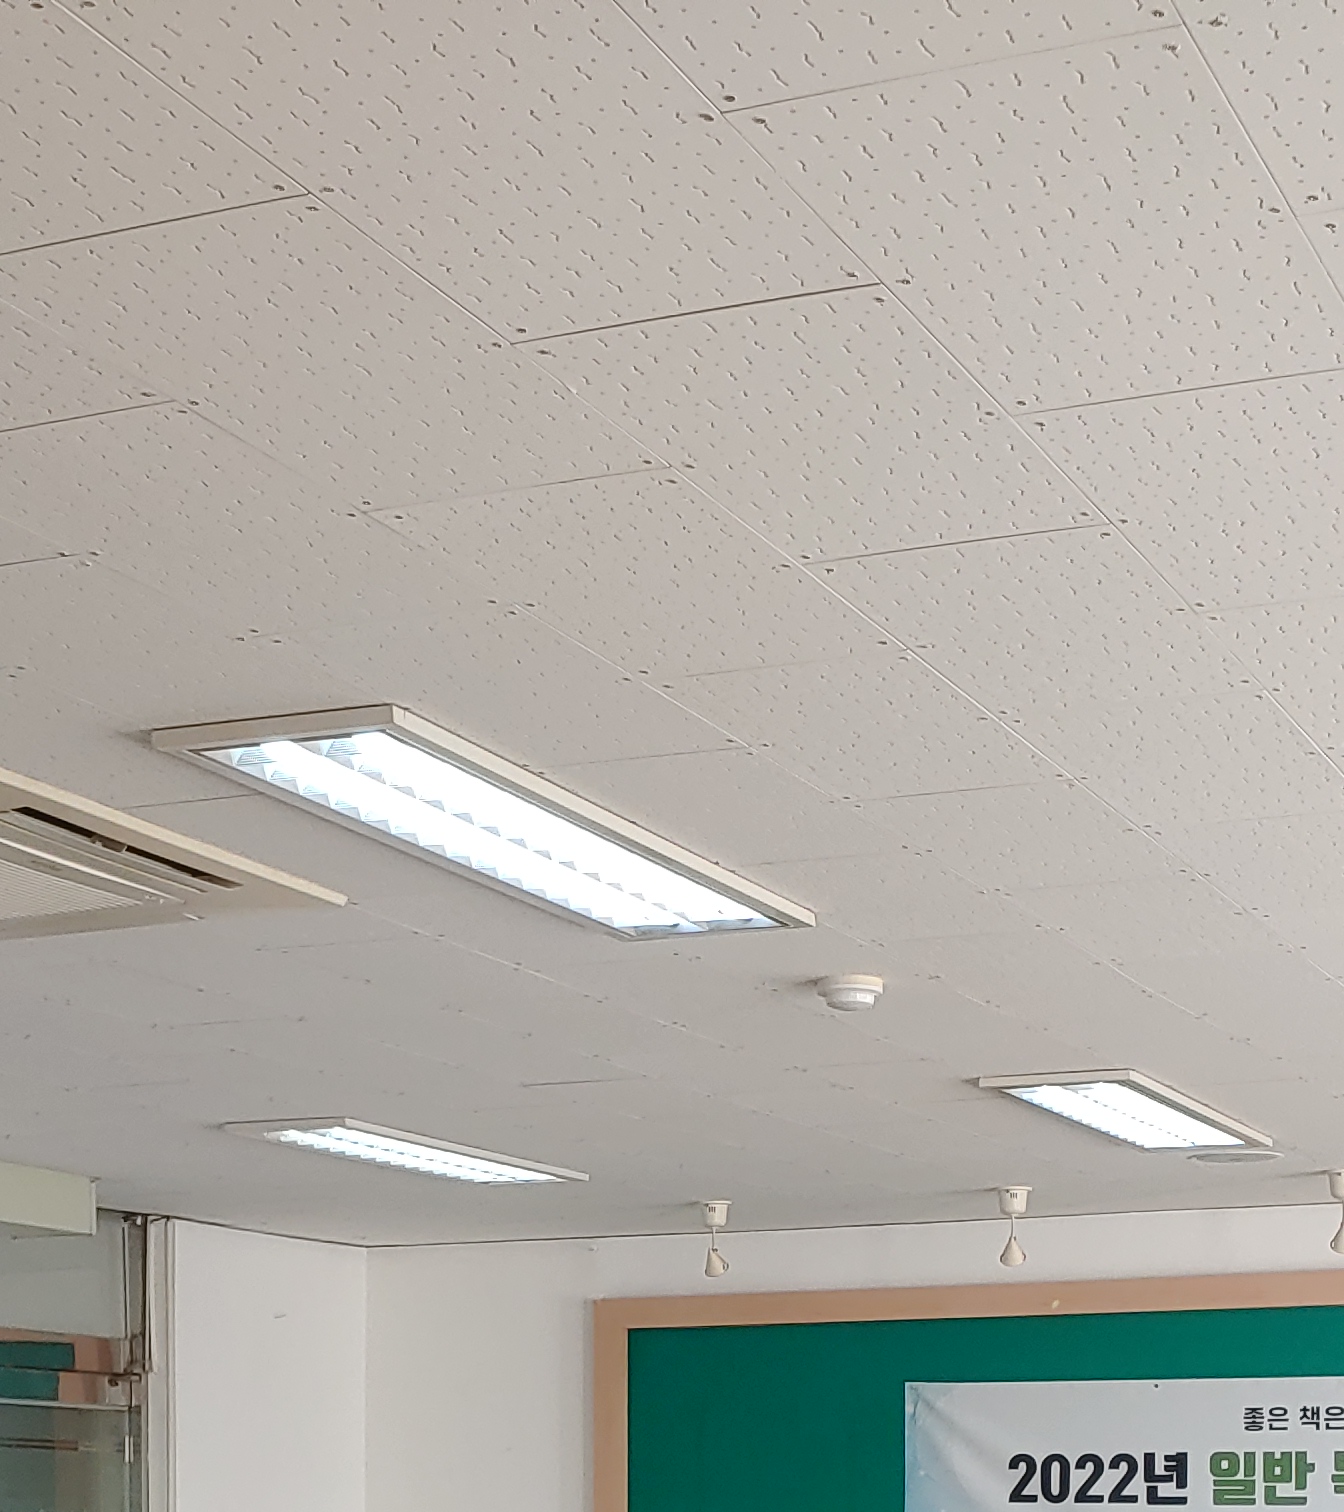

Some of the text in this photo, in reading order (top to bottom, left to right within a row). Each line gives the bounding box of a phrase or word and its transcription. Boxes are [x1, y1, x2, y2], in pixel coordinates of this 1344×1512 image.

[1243, 1405, 1290, 1431] 좋은
[1008, 1451, 1188, 1505] 2022년
[1209, 1450, 1316, 1506] 일반
